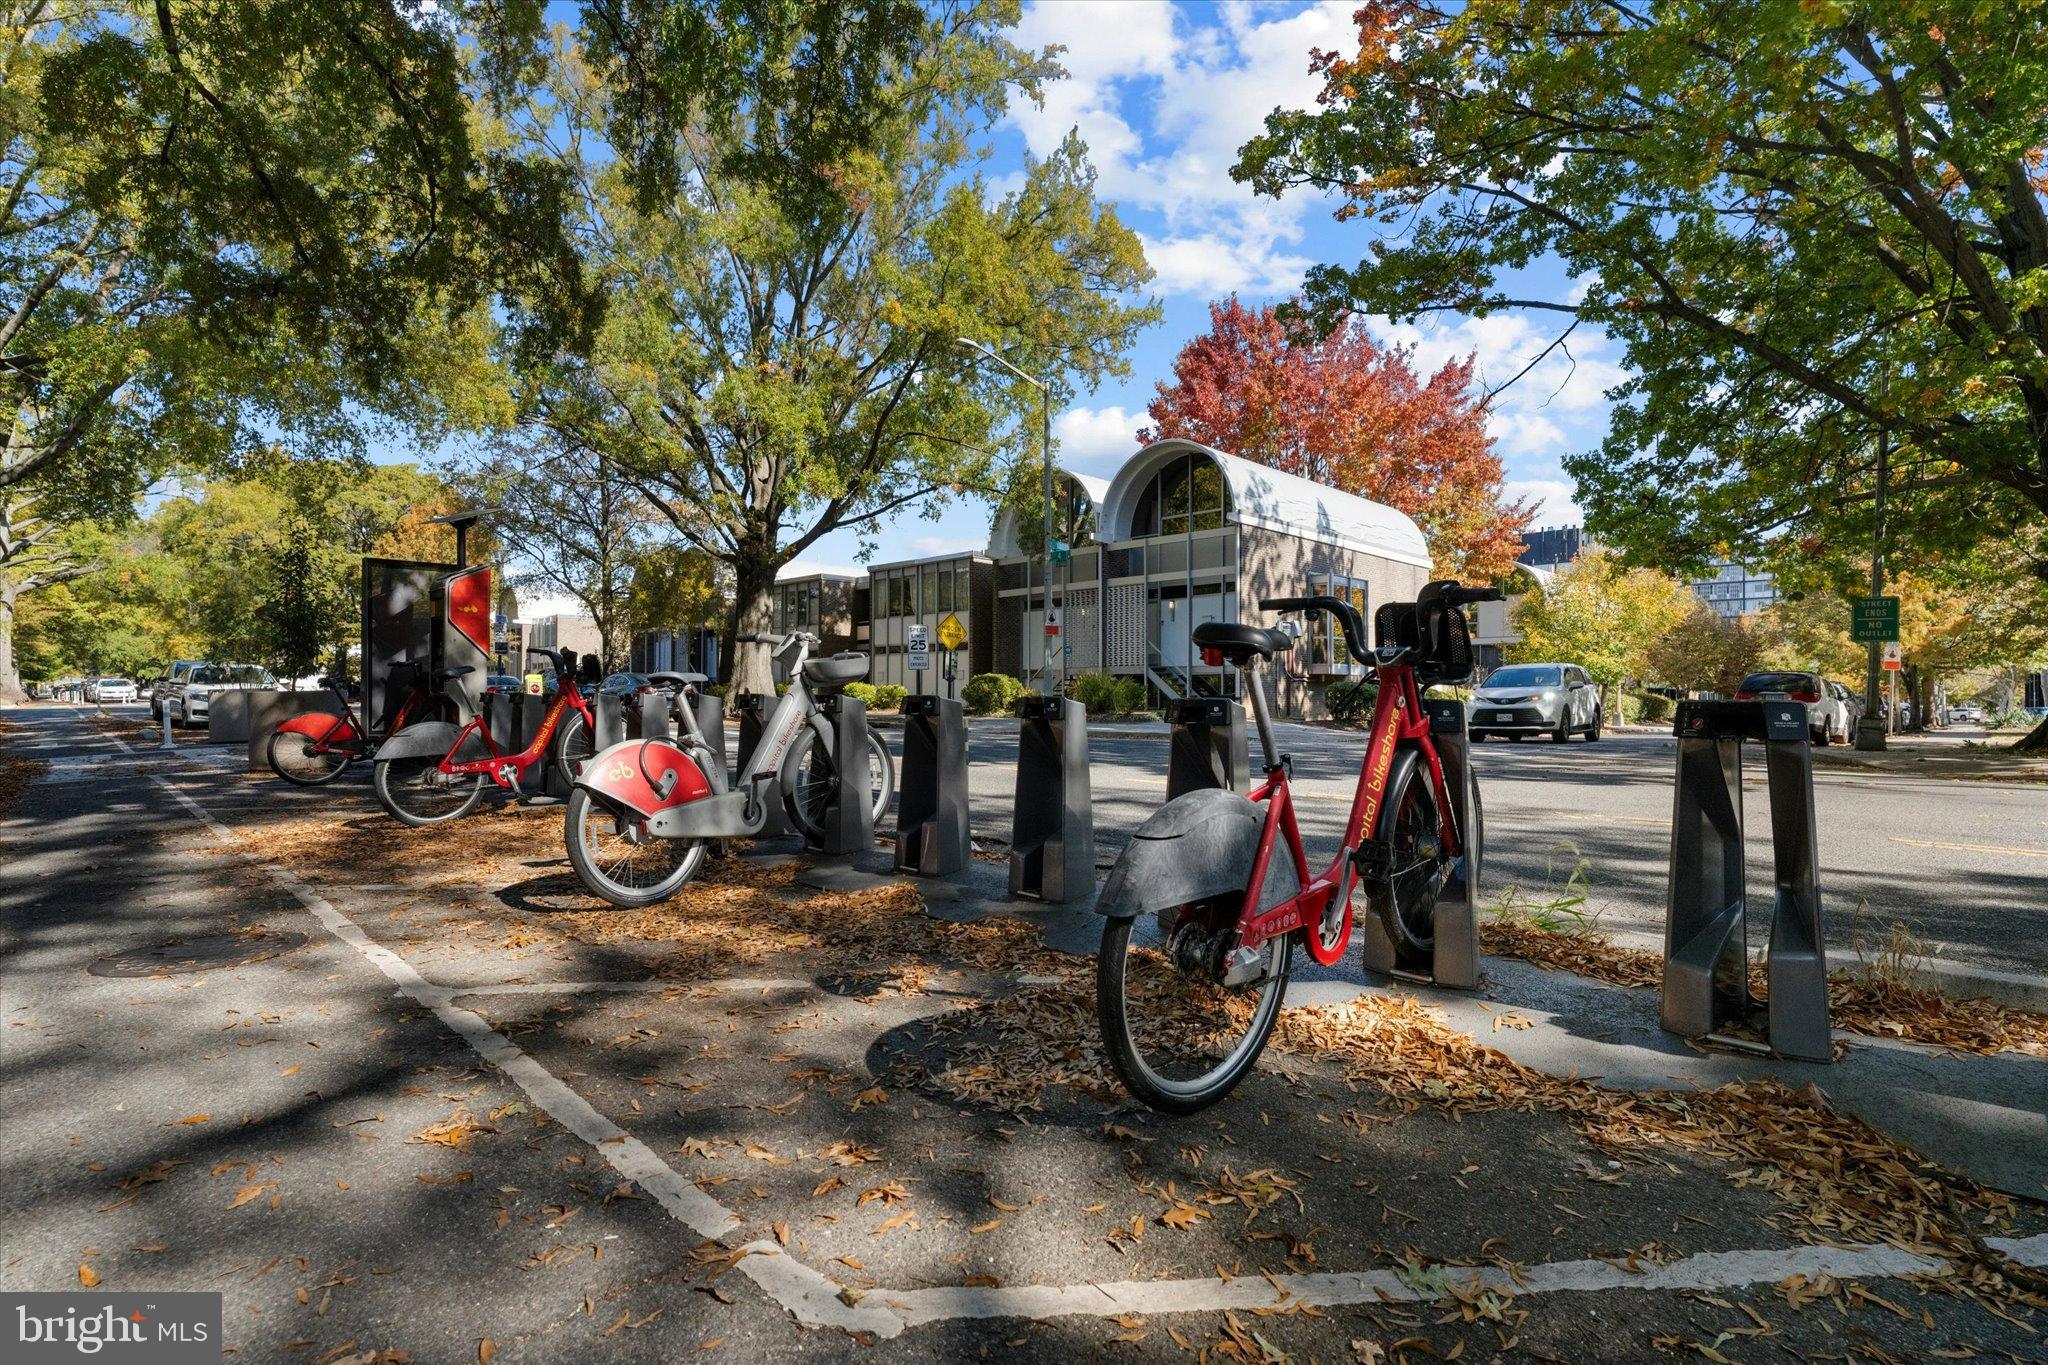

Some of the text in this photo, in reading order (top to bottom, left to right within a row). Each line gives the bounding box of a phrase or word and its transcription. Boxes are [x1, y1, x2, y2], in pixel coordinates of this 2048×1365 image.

[1865, 609, 1887, 617] ENDS
[1868, 620, 1883, 629] NO
[910, 639, 927, 651] 25
[532, 695, 568, 754] capital bikeshare
[778, 710, 802, 747] bikeshare
[1368, 707, 1400, 792] bikeshare
